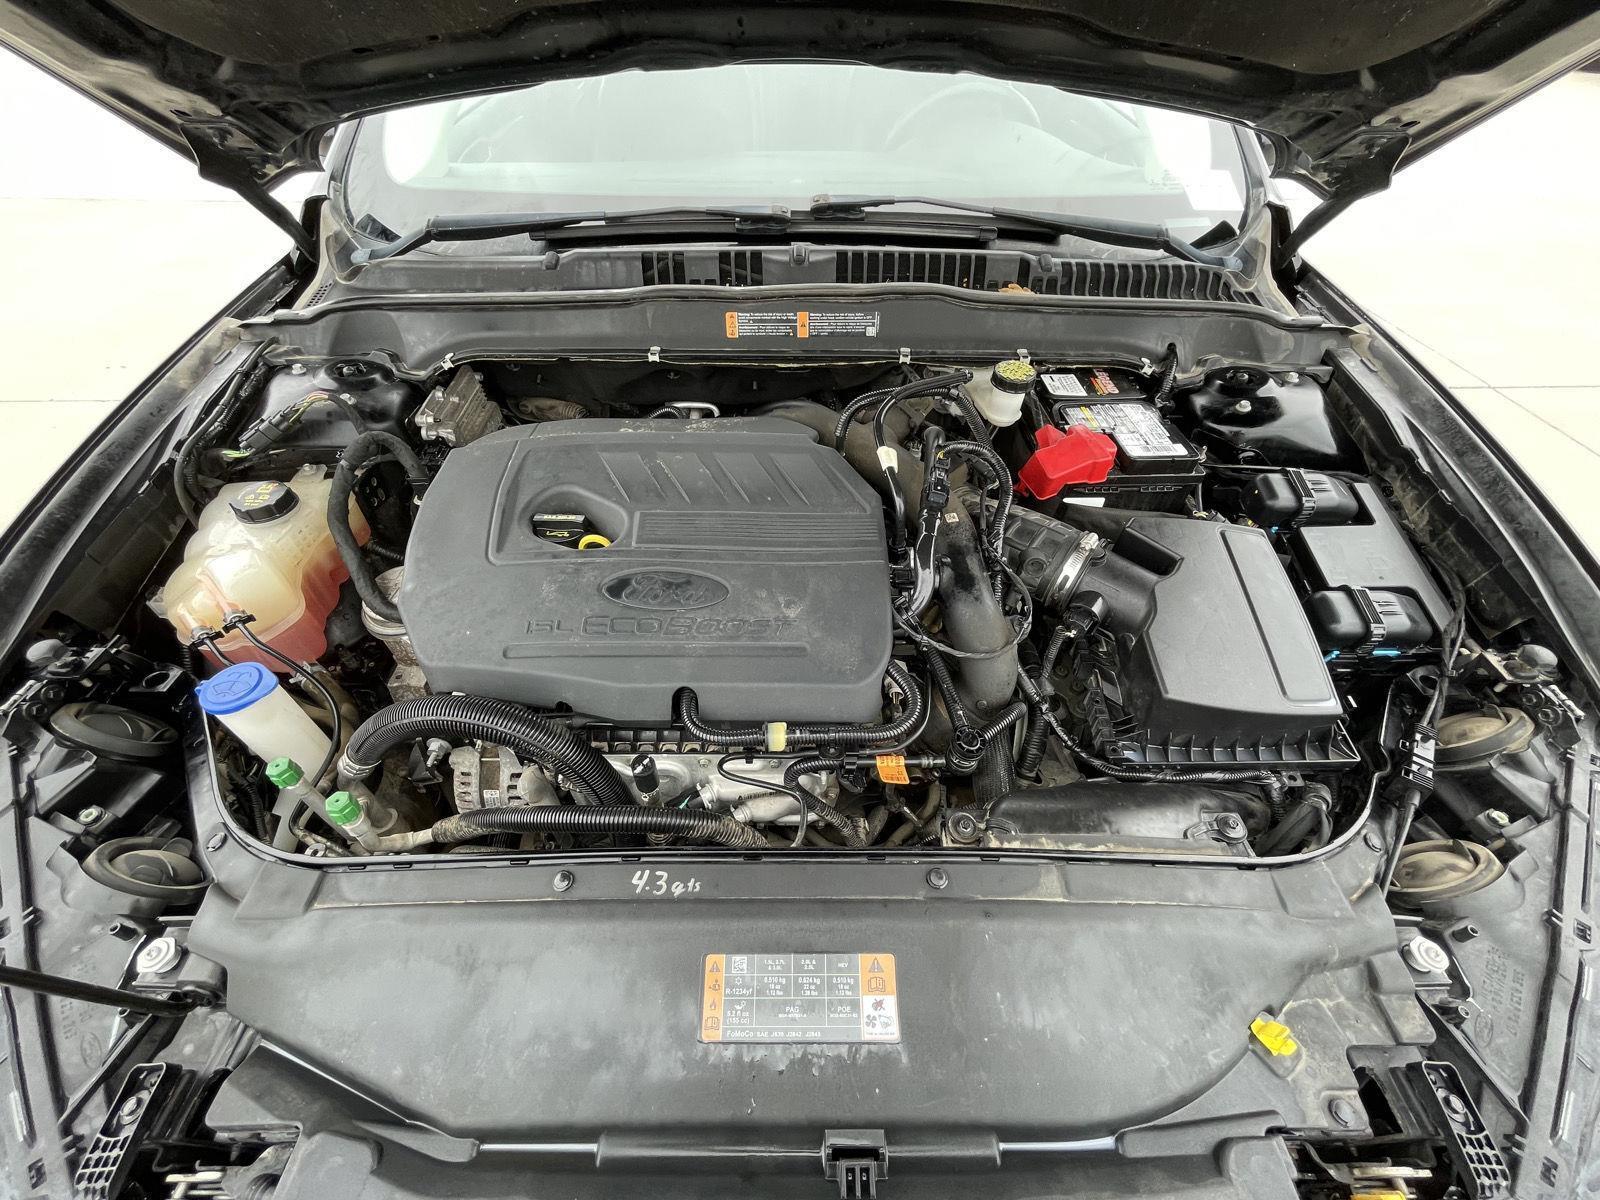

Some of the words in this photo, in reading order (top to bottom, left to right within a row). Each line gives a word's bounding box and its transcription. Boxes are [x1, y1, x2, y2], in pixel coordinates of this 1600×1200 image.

[631, 869, 669, 896] 4.3
[671, 878, 702, 898] qts
[725, 987, 753, 997] R-1234yf
[726, 1030, 754, 1038] FoMoCo
